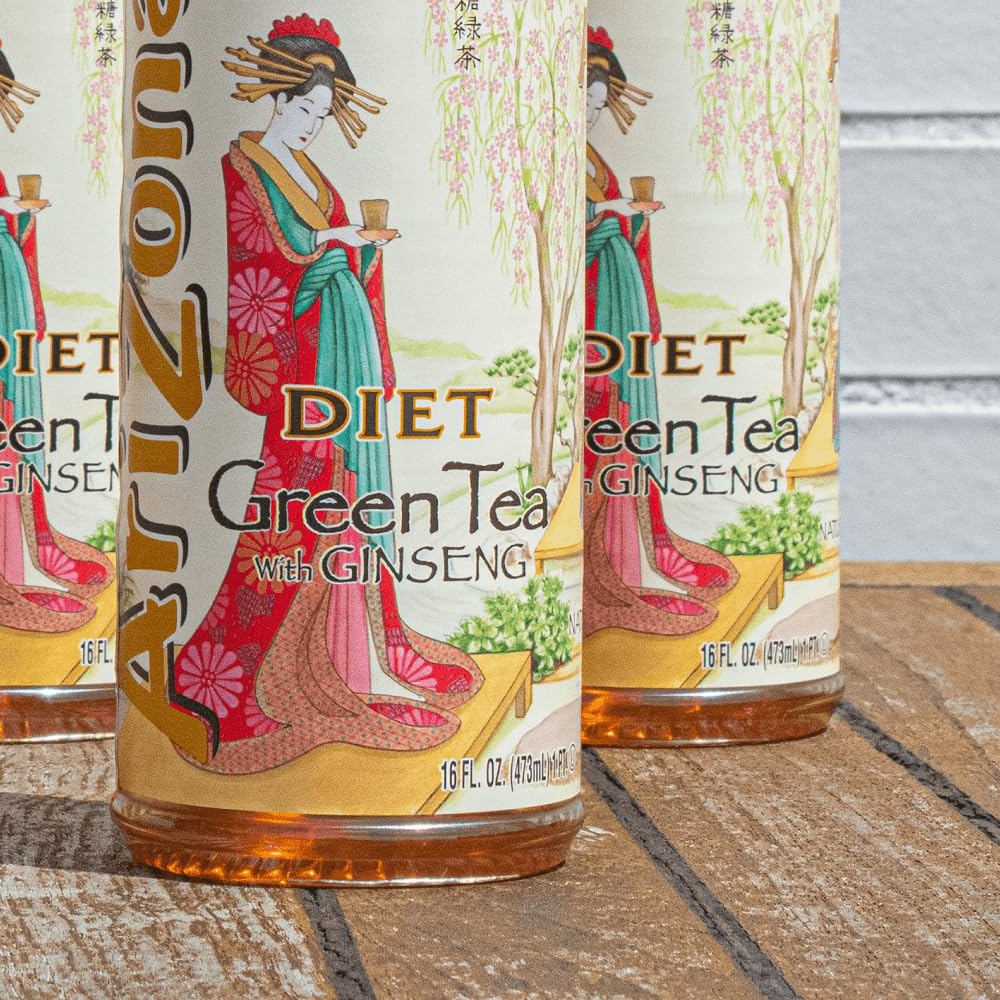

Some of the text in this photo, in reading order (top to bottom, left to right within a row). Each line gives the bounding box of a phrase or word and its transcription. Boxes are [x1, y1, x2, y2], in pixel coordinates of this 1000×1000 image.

[282, 385, 494, 440] DIET
[584, 394, 800, 456] een Tea
[208, 459, 549, 535] Green Tea
[600, 463, 779, 496] GINSENG
[254, 543, 528, 584] With GINSENG
[80, 639, 113, 665] 16 FL.
[700, 643, 716, 668] 16
[719, 643, 737, 667] FL.
[741, 642, 760, 666] OZ.
[763, 638, 801, 671] (473mL)
[440, 759, 457, 790] 16
[461, 759, 481, 789] FL.
[486, 757, 506, 787] OZ.
[510, 751, 550, 792] (473mL)
